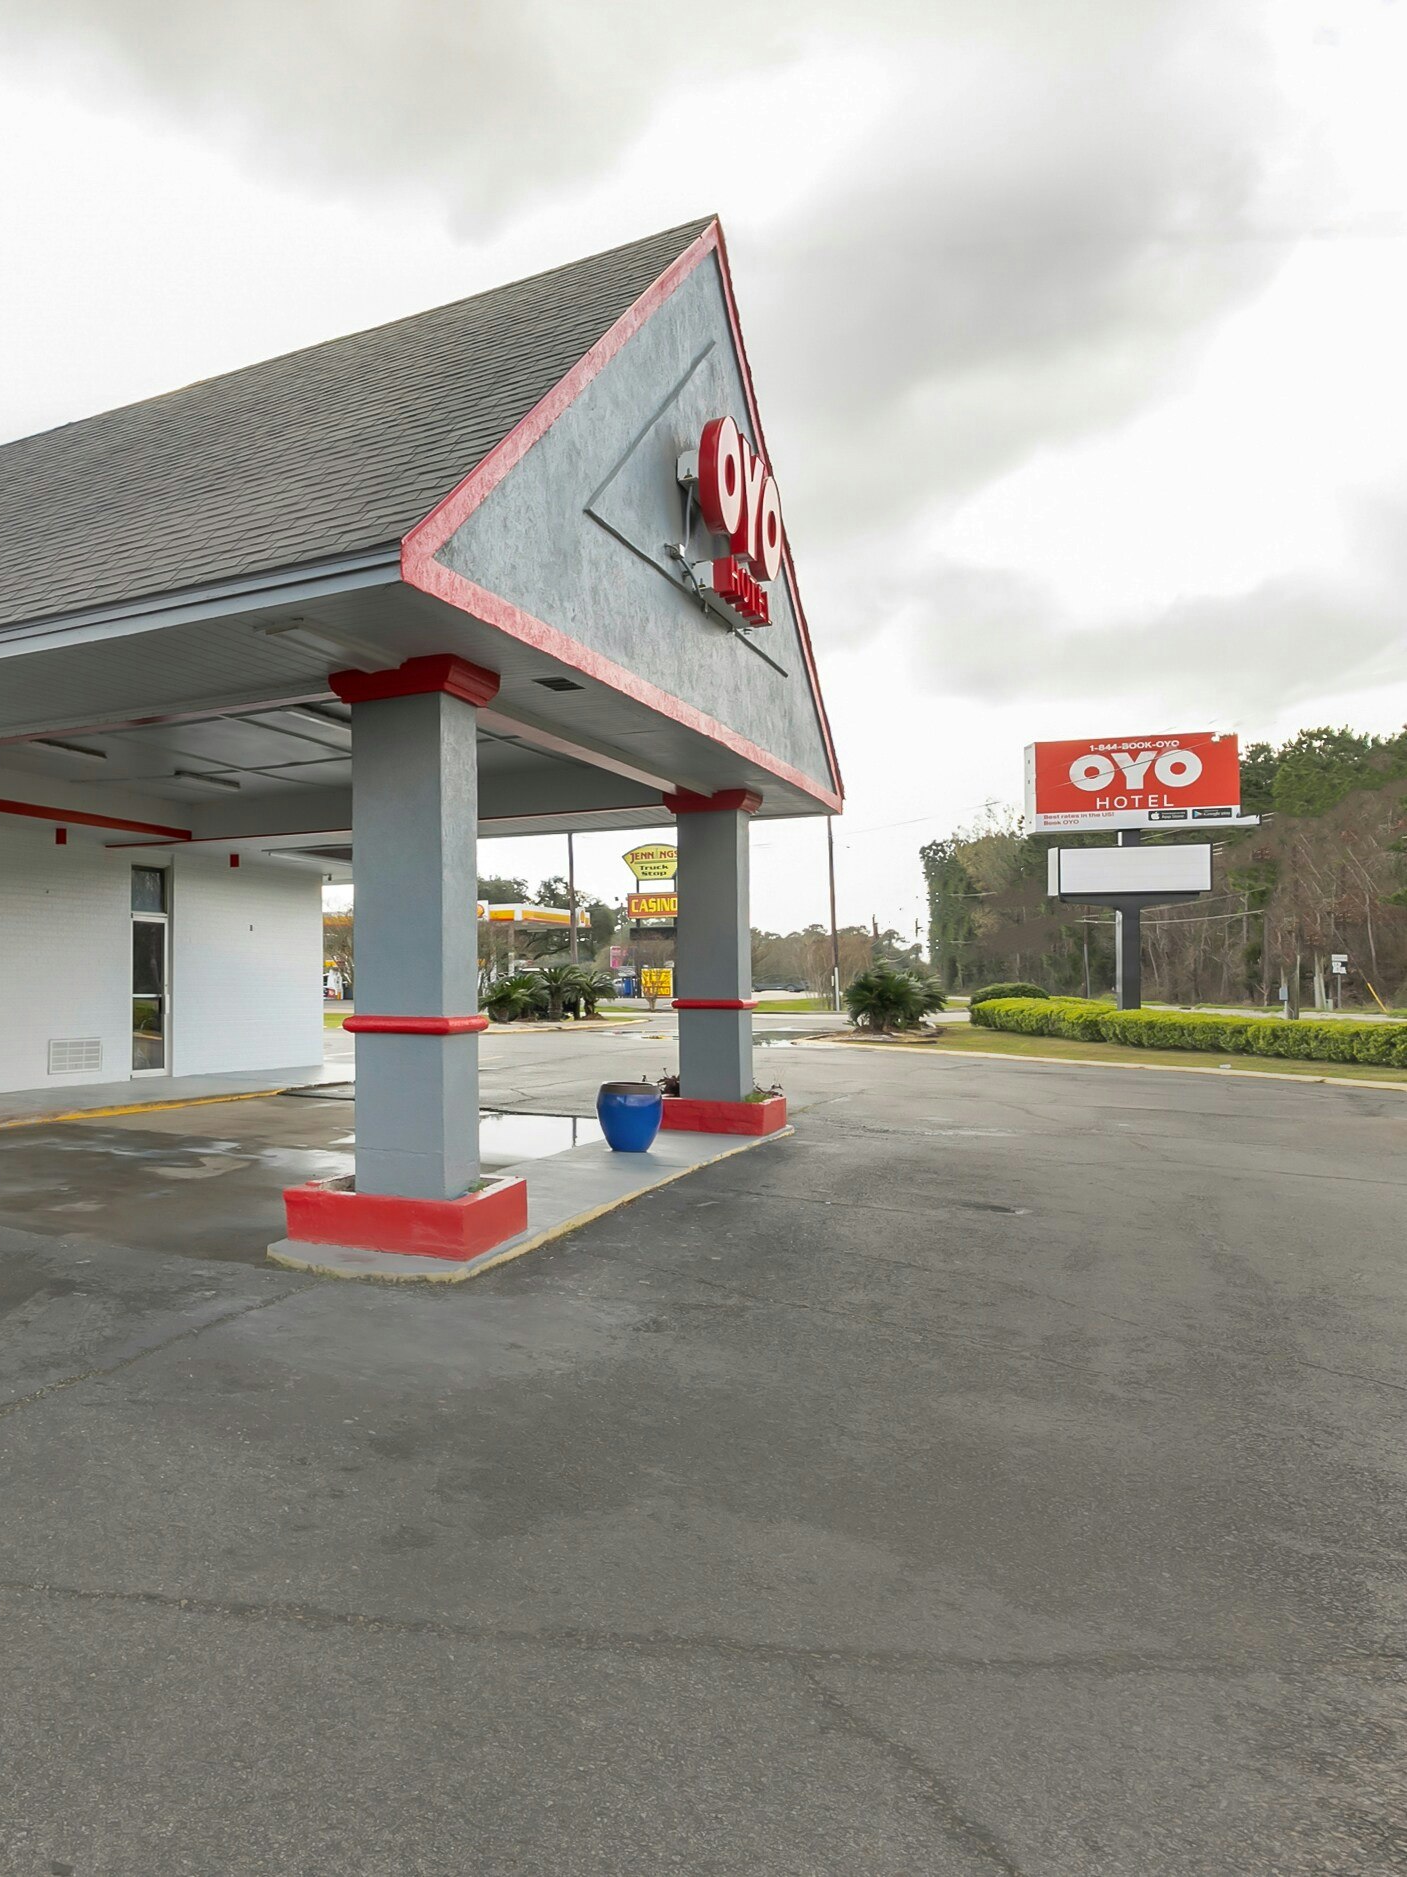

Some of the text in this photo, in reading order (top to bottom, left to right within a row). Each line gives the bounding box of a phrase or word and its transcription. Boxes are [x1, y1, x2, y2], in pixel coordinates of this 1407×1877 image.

[700, 416, 782, 582] OYO
[1089, 740, 1180, 752] 1-844-BOOK-OYO
[1069, 750, 1202, 792] OYO
[1096, 794, 1174, 810] HOTEL
